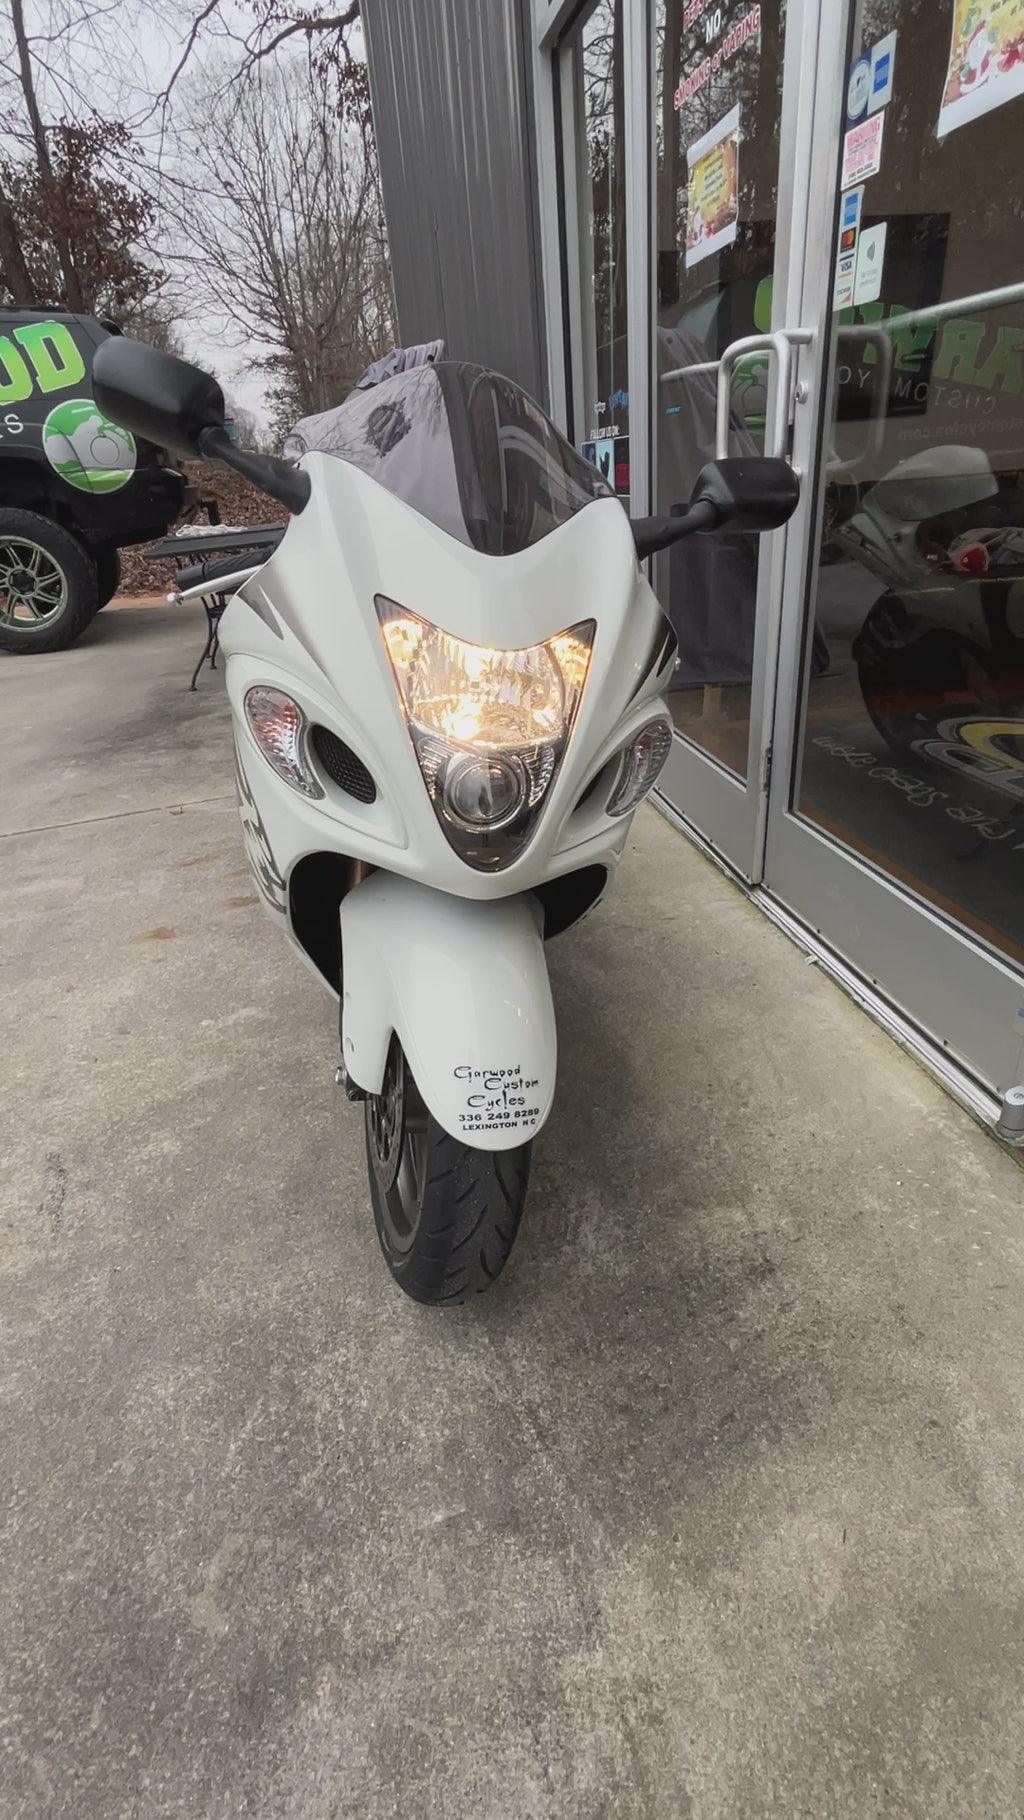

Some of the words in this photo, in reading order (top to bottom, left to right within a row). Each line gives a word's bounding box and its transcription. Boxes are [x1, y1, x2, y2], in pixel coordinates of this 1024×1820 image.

[706, 8, 721, 43] NO
[674, 56, 711, 110] SMOKING
[722, 4, 761, 61] VAPING
[454, 1064, 521, 1083] Garwood
[484, 1077, 539, 1090] Custom
[467, 1090, 526, 1111] Cycles
[458, 1113, 482, 1122] 336
[487, 1112, 511, 1120] 249
[514, 1108, 540, 1118] 8289
[462, 1121, 518, 1131] LEXINGTON
